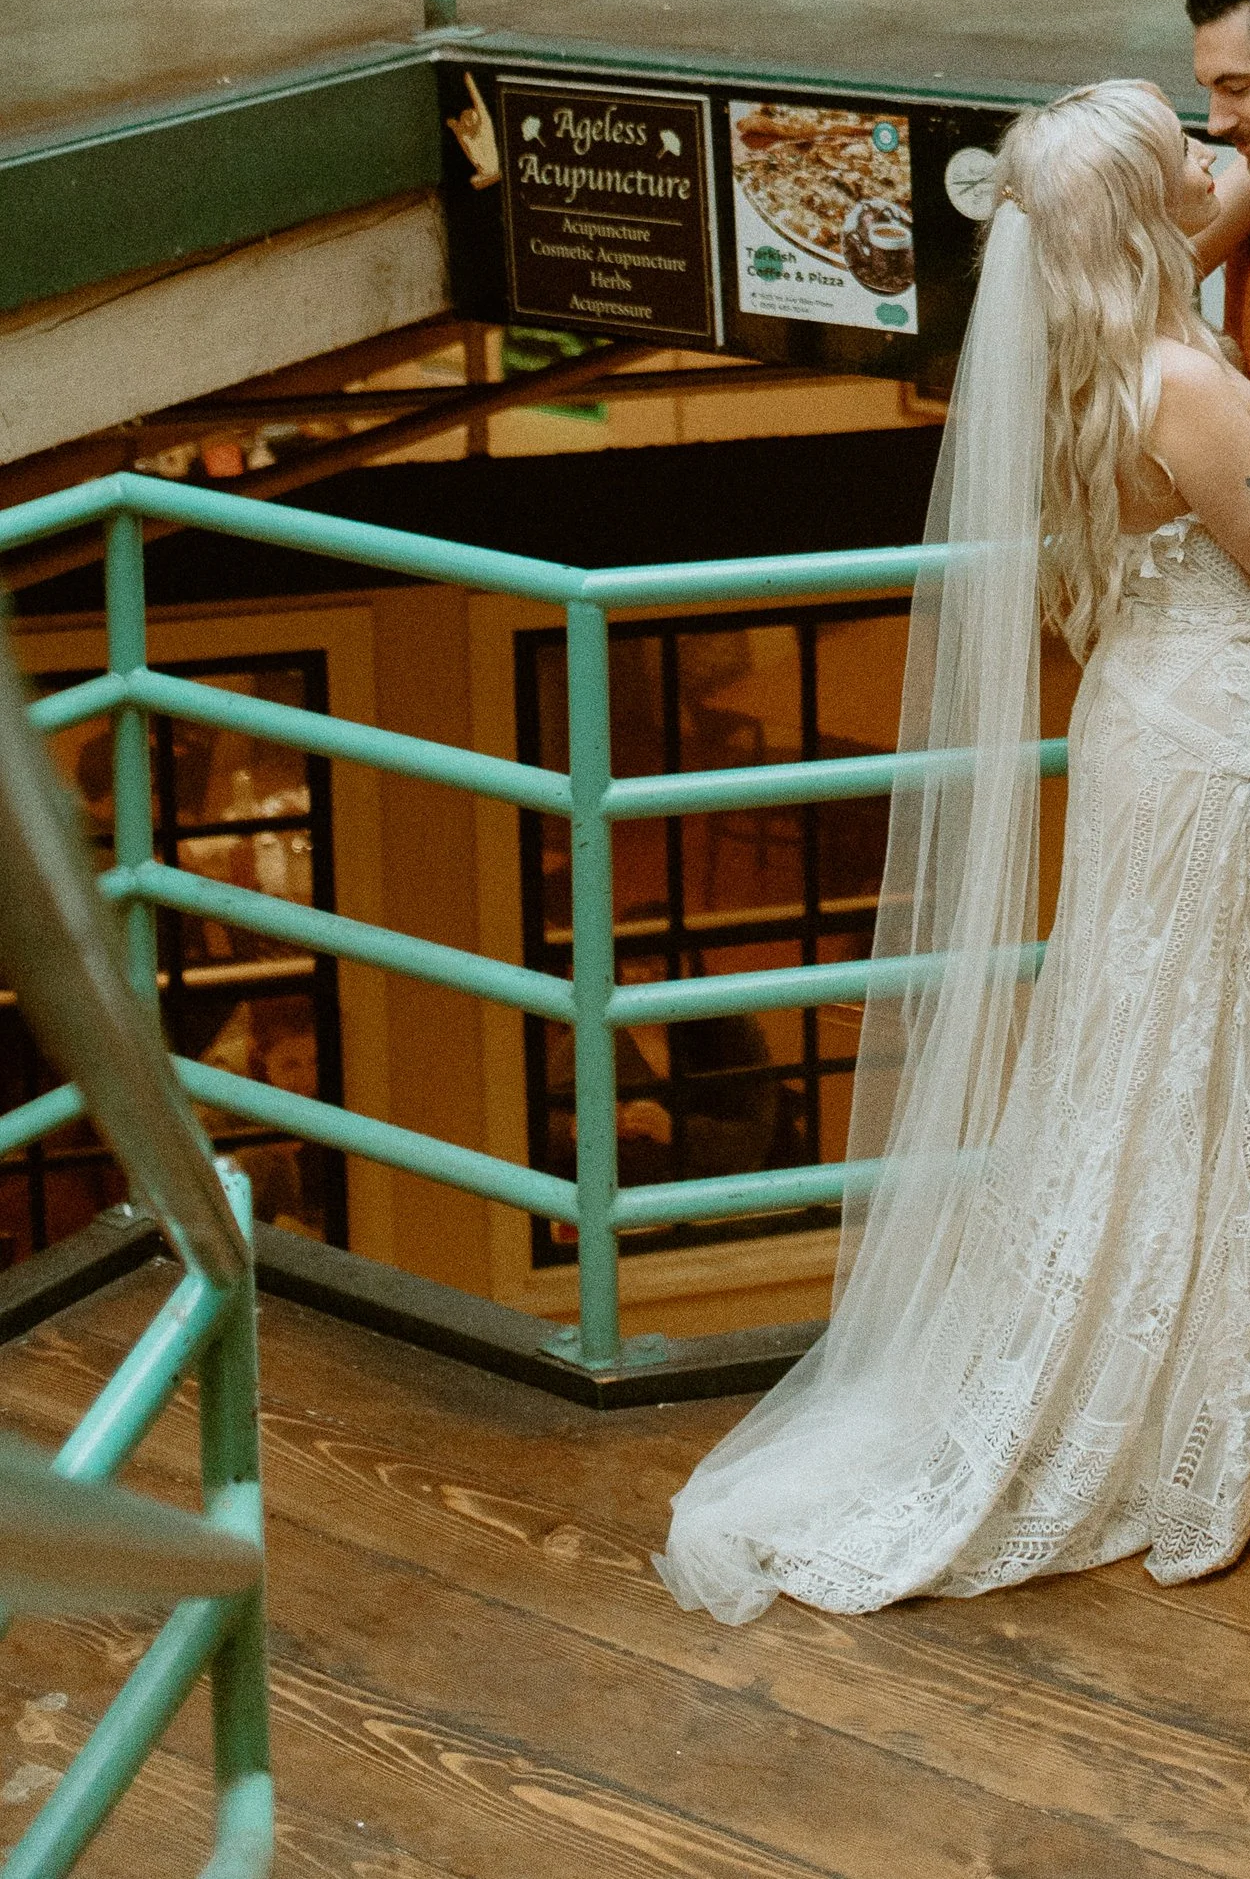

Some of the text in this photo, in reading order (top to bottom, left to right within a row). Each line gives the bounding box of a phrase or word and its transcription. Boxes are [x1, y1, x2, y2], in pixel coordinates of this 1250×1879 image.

[553, 107, 648, 154] Ageless
[517, 154, 691, 203] Acupuncture
[562, 218, 651, 243] Acupuncture
[530, 237, 687, 273] Cosmetic Acupuncture
[746, 247, 797, 264] Turkish
[590, 270, 632, 292] Herbs
[747, 265, 845, 288] Coffee & Pizza
[570, 294, 653, 320] Acupressure
